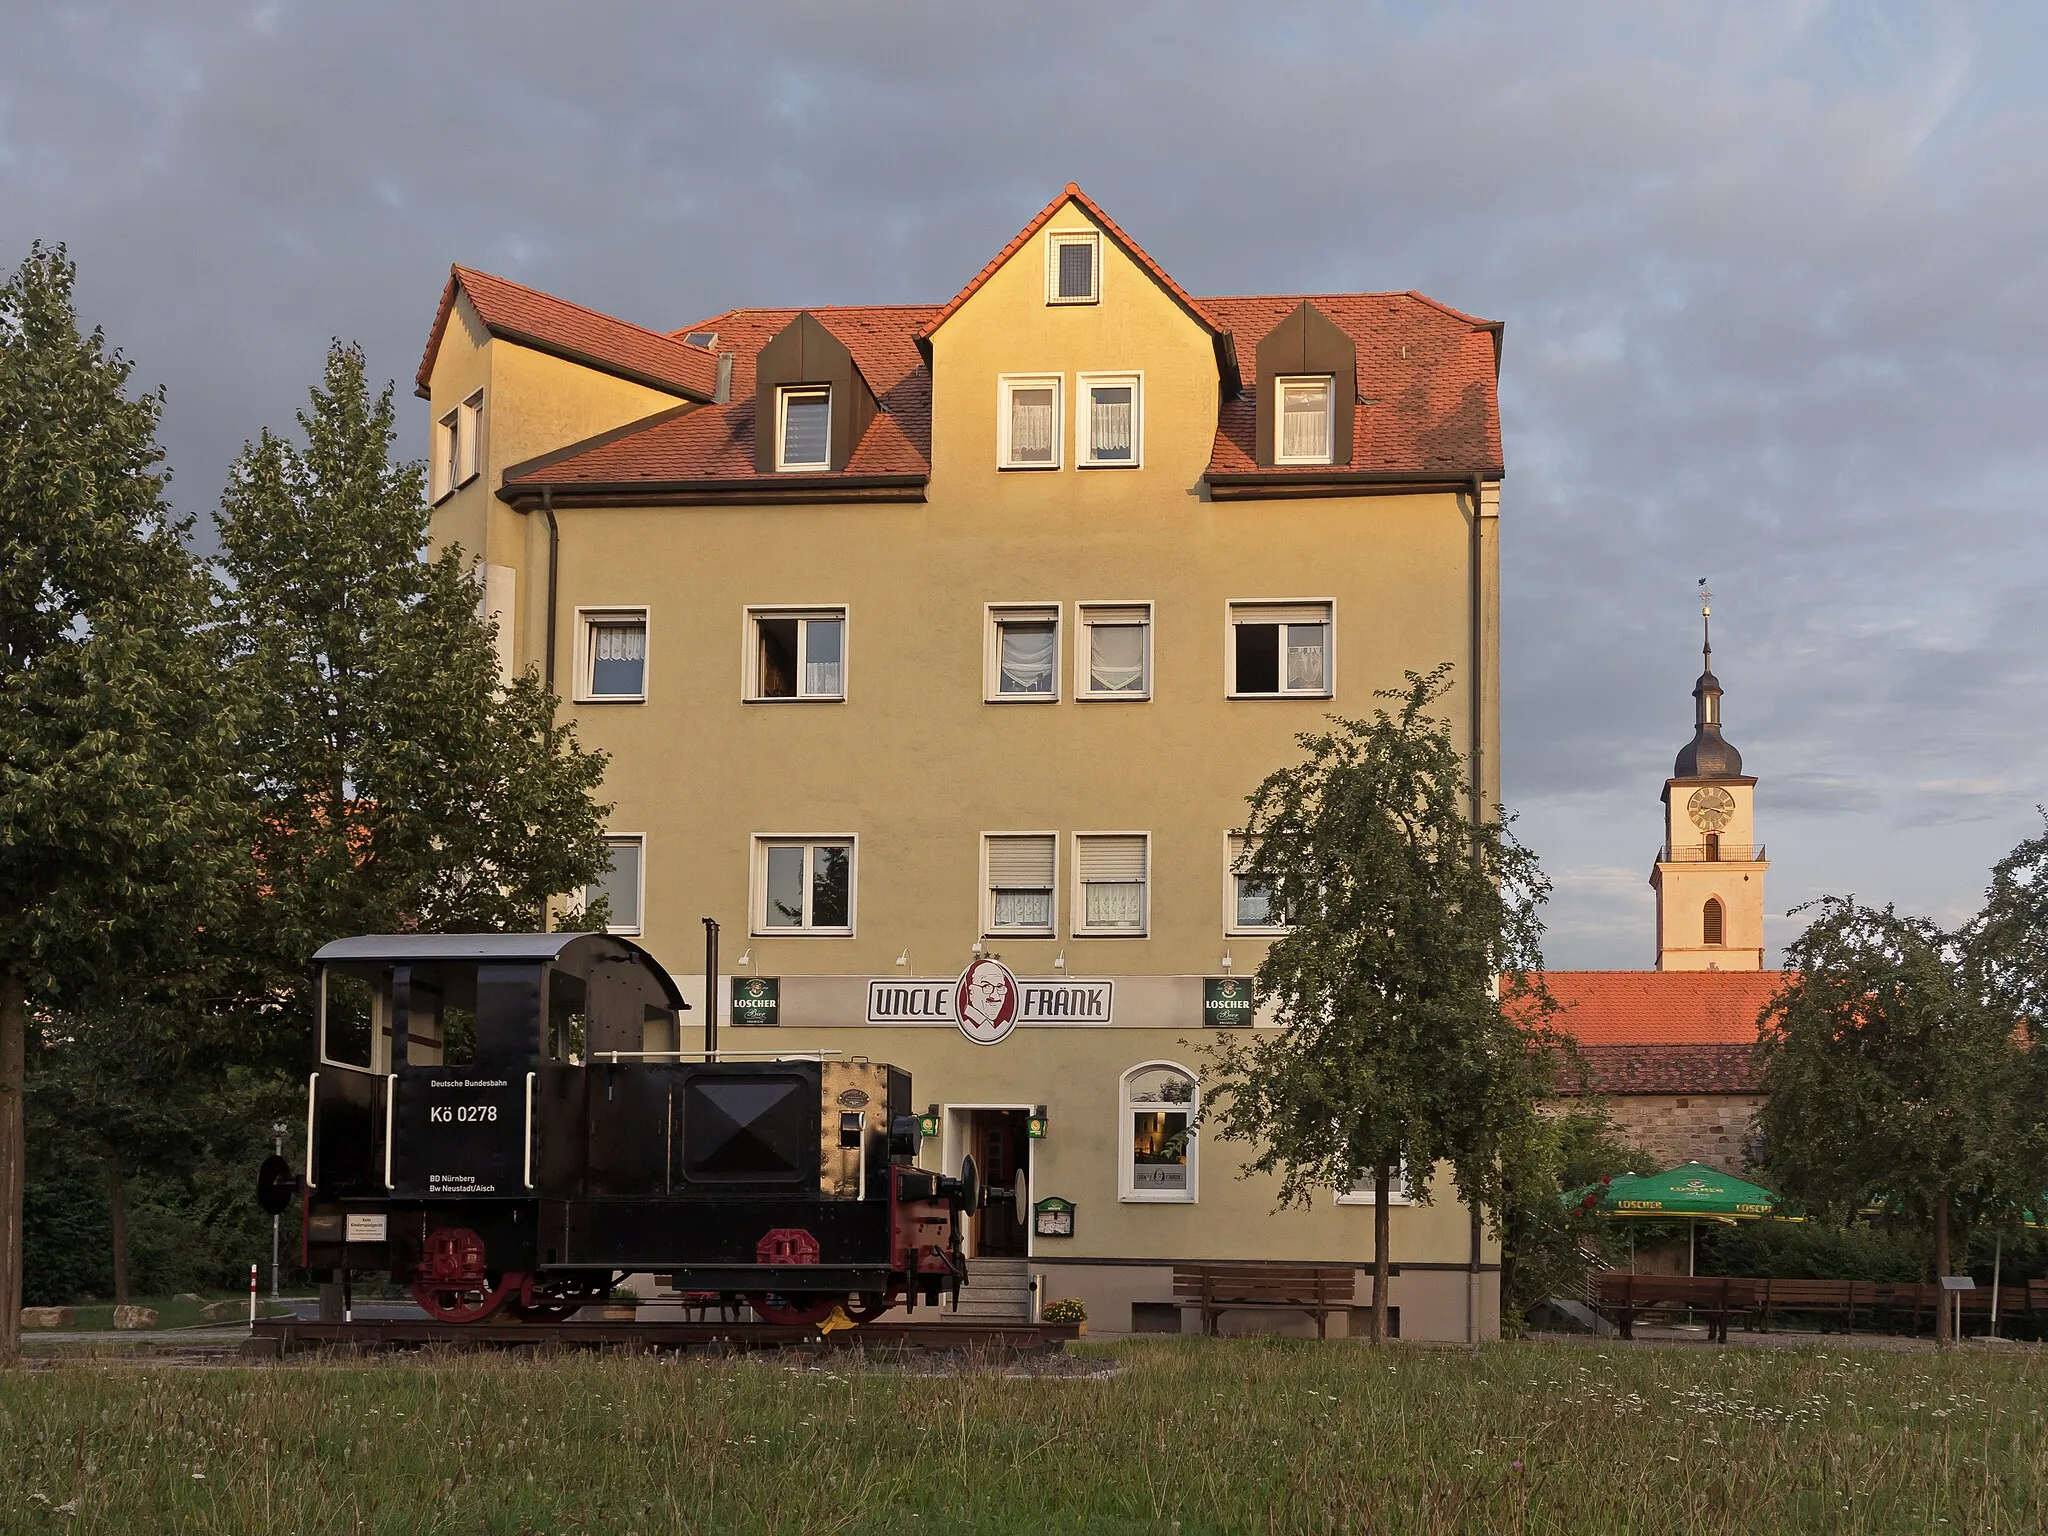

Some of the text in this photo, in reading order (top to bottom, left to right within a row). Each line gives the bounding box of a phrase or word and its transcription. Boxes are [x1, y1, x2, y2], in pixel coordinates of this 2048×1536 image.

[734, 999, 776, 1008] LOSCHER
[876, 988, 949, 1016] UNCLE
[1206, 1000, 1250, 1009] LOSCHER
[430, 1079, 508, 1088] Deutsche Bundesbahn
[430, 1106, 497, 1122] Kö 0278
[441, 1174, 475, 1184] Nürnberg
[442, 1184, 495, 1193] Neustadt/Aisch
[1618, 1200, 1662, 1209] LOSCHER
